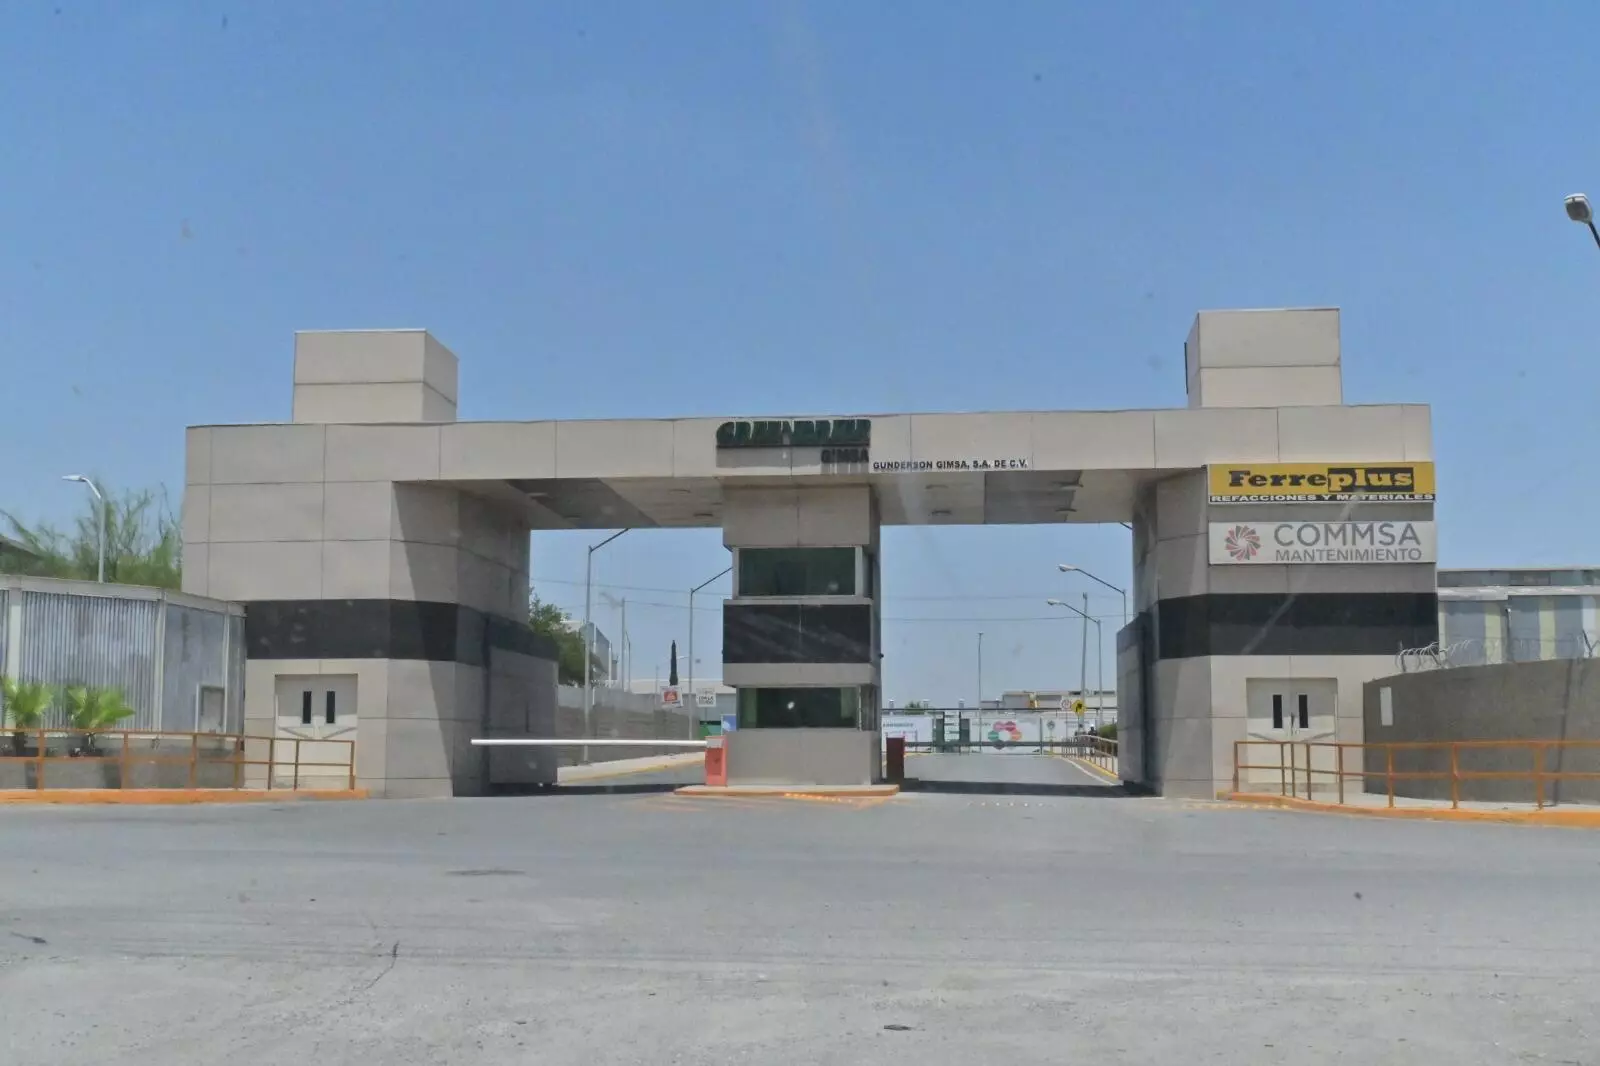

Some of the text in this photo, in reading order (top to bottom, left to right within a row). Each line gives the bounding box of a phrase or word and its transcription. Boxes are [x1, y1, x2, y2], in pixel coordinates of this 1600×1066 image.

[873, 461, 933, 471] GUNDERSON
[994, 459, 1007, 469] DE
[1009, 459, 1028, 469] C.V.
[1228, 468, 1414, 492] Ferreplus
[1211, 494, 1317, 502] REFACCIONES
[1273, 522, 1422, 547] COMMSA
[1275, 547, 1422, 563] MANTENIMIENTO
